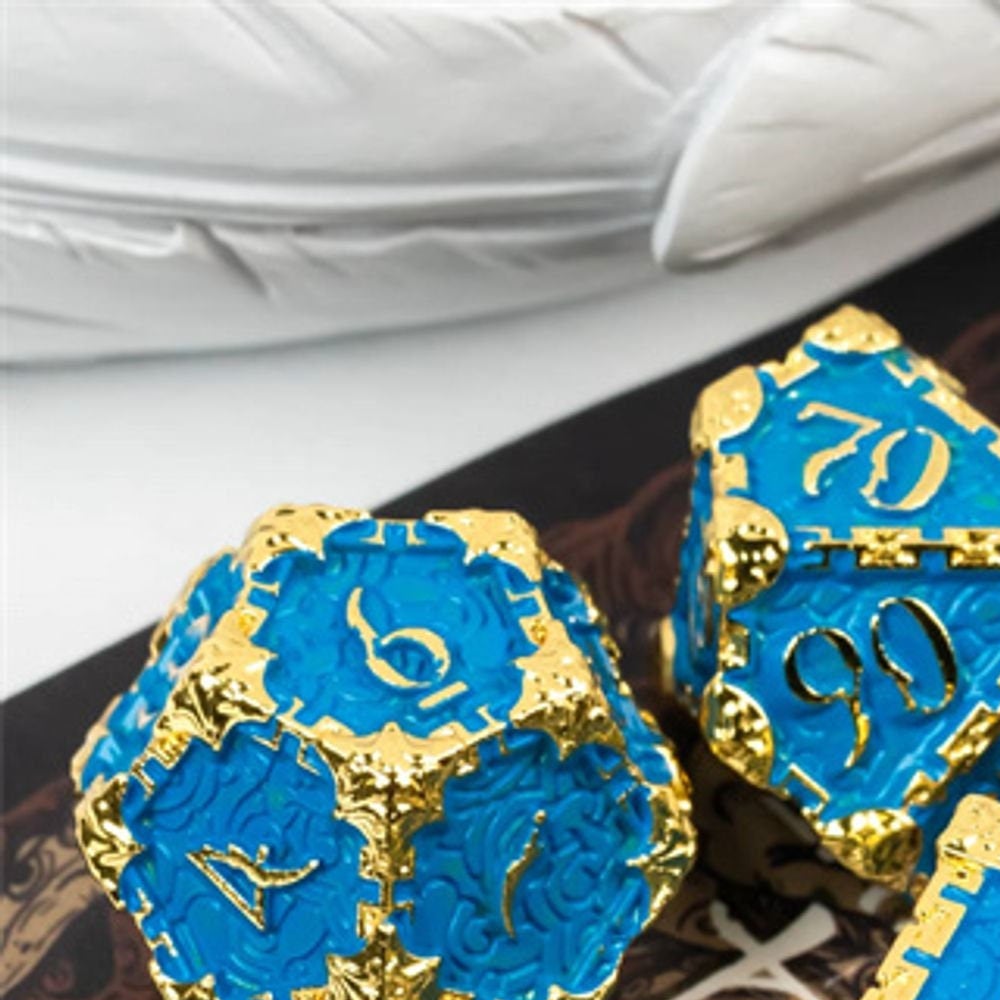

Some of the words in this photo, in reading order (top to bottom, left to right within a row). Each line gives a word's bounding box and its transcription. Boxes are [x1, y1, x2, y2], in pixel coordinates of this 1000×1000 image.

[797, 401, 952, 512] 70
[784, 598, 957, 769] 90
[187, 844, 320, 931] 4
